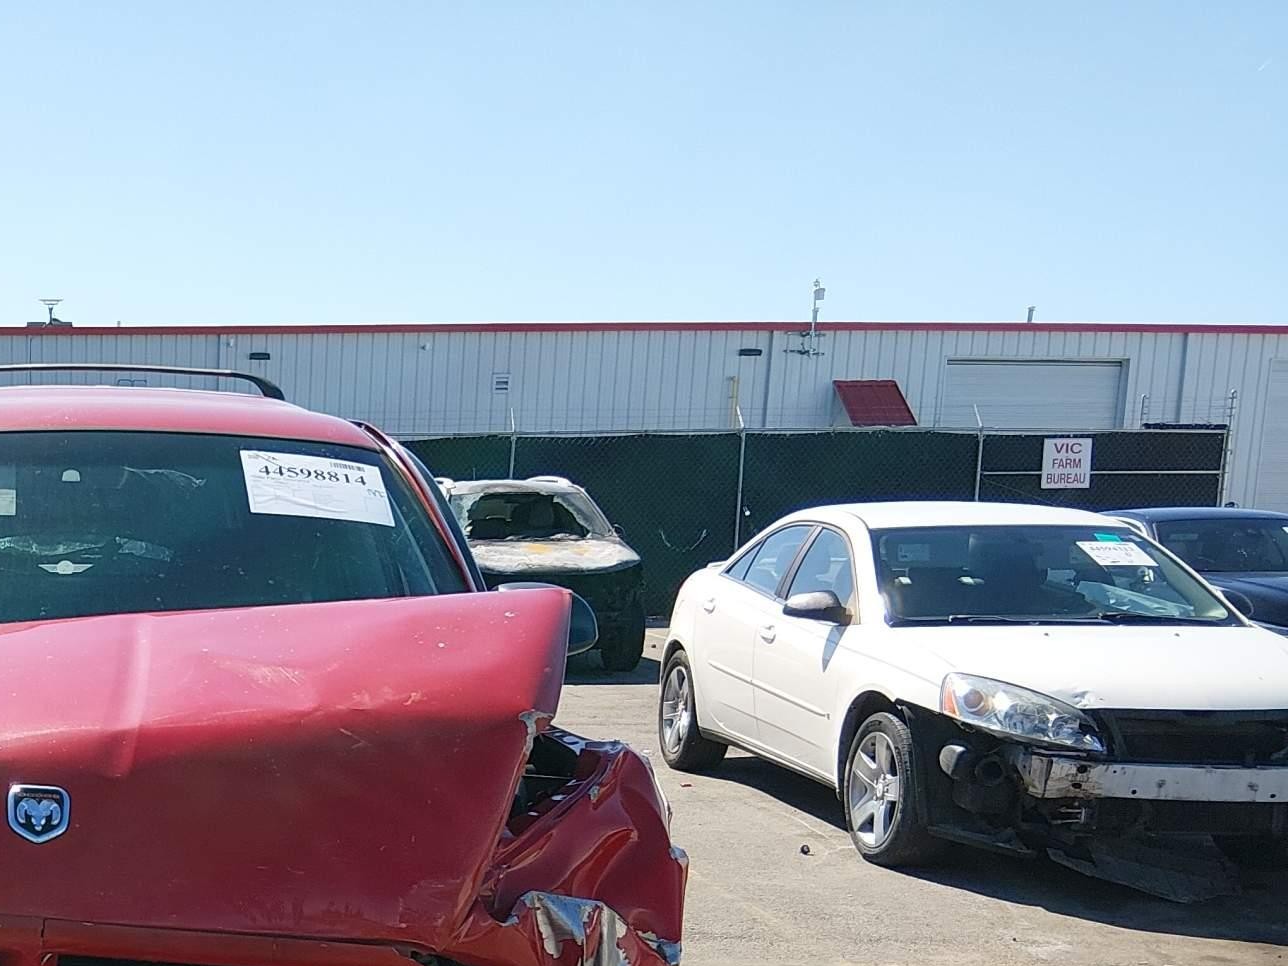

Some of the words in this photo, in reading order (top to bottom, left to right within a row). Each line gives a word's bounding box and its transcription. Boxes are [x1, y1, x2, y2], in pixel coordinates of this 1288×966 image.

[1054, 443, 1082, 454] VIC
[1052, 458, 1082, 469] FARM
[259, 465, 367, 486] 44598814
[1046, 473, 1086, 484] BUREAU
